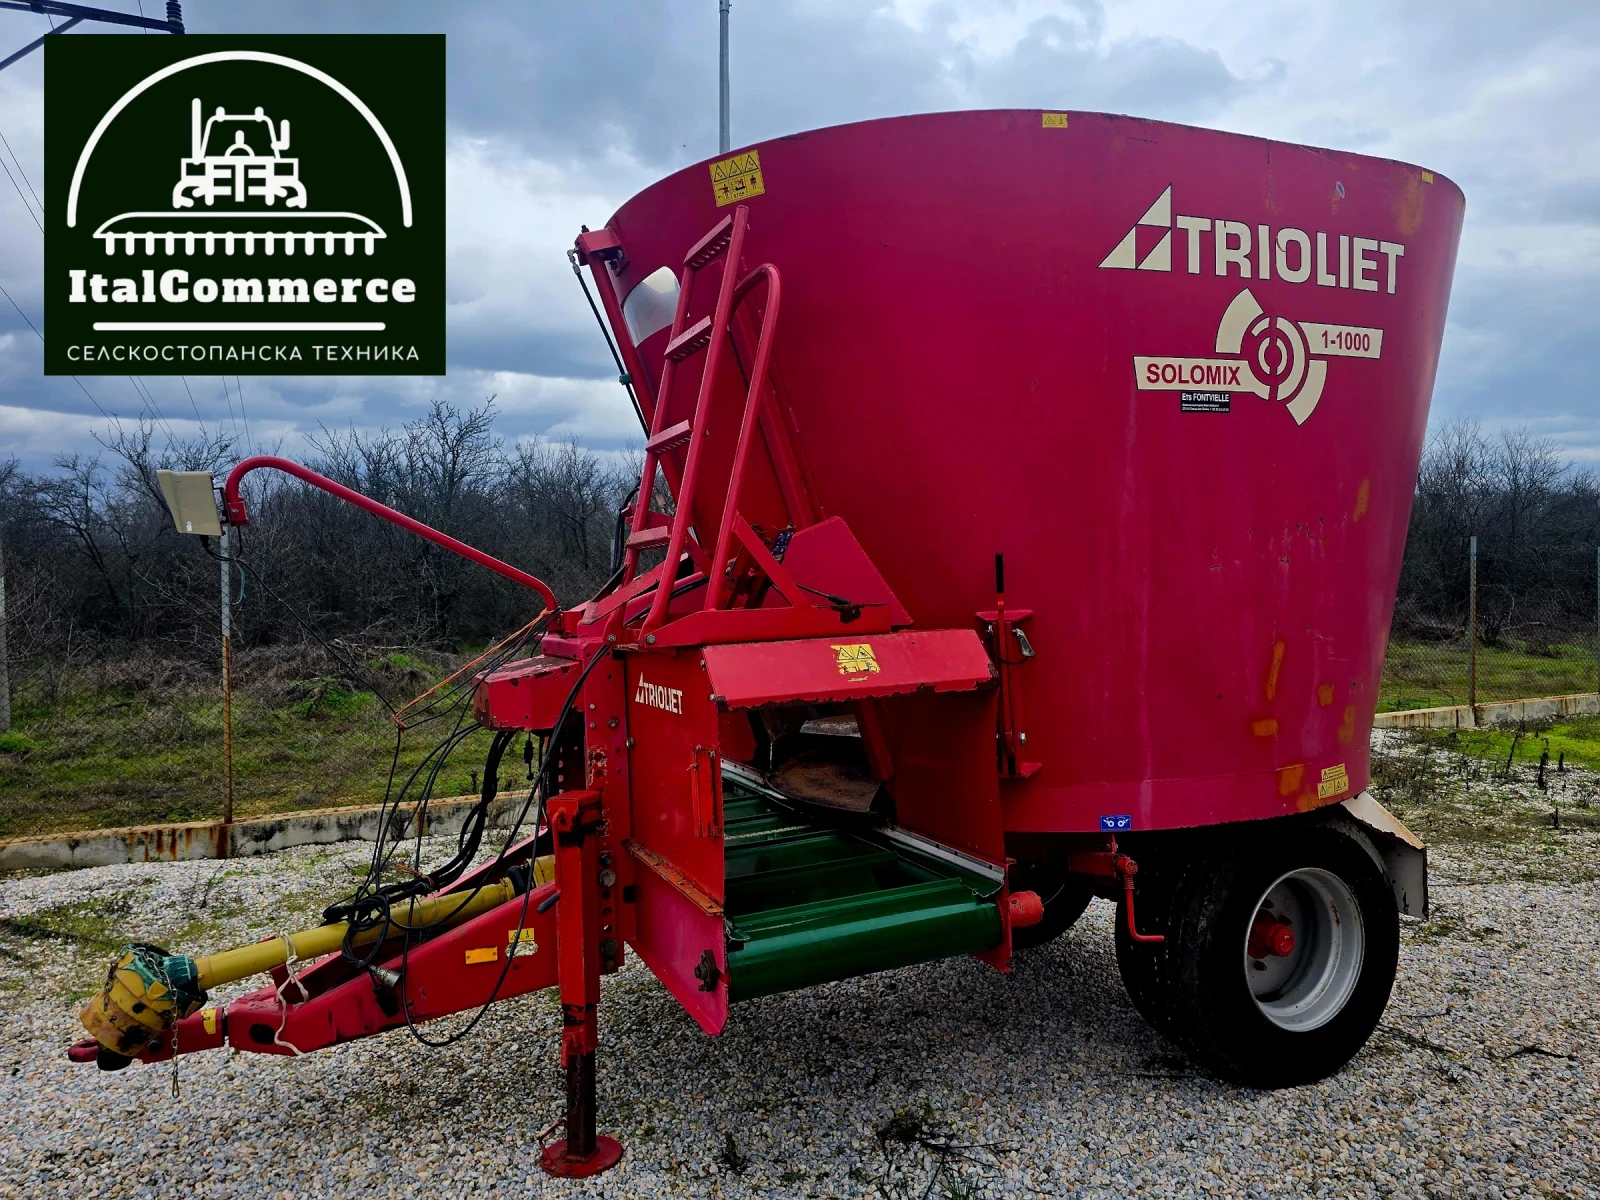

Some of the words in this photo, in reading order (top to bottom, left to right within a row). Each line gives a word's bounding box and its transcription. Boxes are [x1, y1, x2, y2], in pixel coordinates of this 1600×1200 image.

[1176, 214, 1405, 295] TRIOLIET
[1321, 330, 1371, 352] 1-1000
[1146, 363, 1241, 386] SOLOMIX
[643, 682, 683, 715] TRIOLIET
